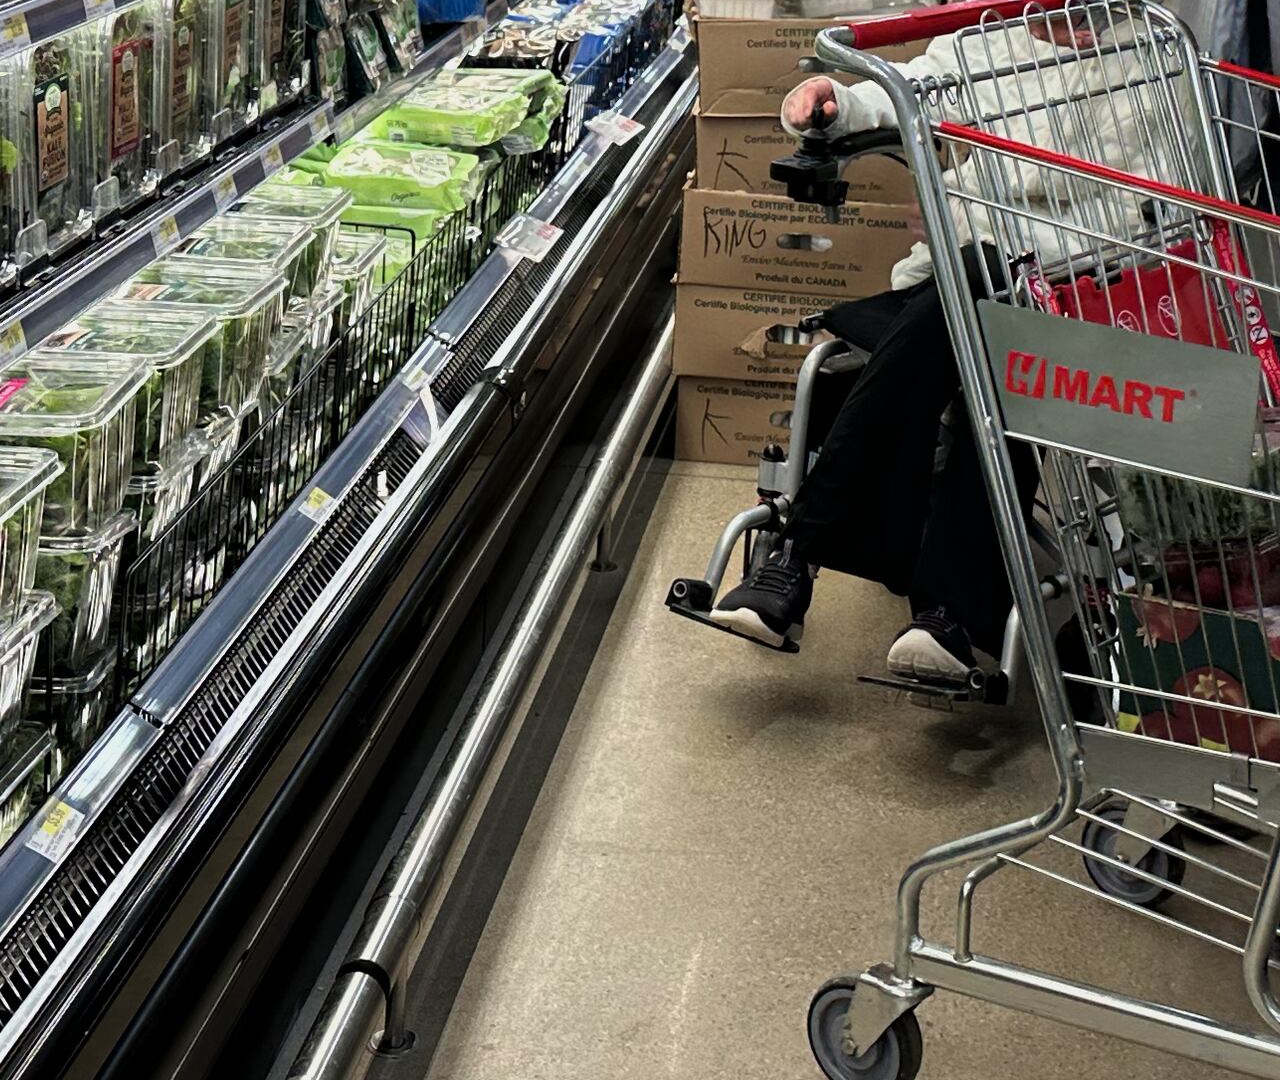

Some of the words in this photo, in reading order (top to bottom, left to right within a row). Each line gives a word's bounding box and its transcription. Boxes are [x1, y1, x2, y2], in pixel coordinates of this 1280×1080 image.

[747, 39, 787, 50] Certified
[789, 39, 802, 51] by
[744, 134, 788, 146] Certified
[788, 135, 798, 147] by
[752, 199, 796, 212] CERTIFIE
[704, 205, 737, 218] Certifie
[739, 208, 789, 223] Biologique
[790, 214, 805, 225] par
[866, 219, 908, 230] CANADA
[703, 207, 768, 258] KING
[741, 254, 772, 266] Enviro
[773, 256, 821, 269] Mushroom
[822, 260, 847, 272] Farm
[755, 272, 789, 284] Produit
[791, 273, 804, 285] du
[805, 276, 848, 288] CANADA
[743, 292, 788, 304] CERTIFIE
[694, 298, 728, 309] Certifie
[730, 301, 780, 315] Biologique
[781, 306, 797, 317] par
[747, 364, 780, 375] Produit
[781, 365, 795, 375] du
[697, 384, 730, 396] Certifie
[732, 387, 780, 401] Biologique
[1053, 365, 1186, 423] MART
